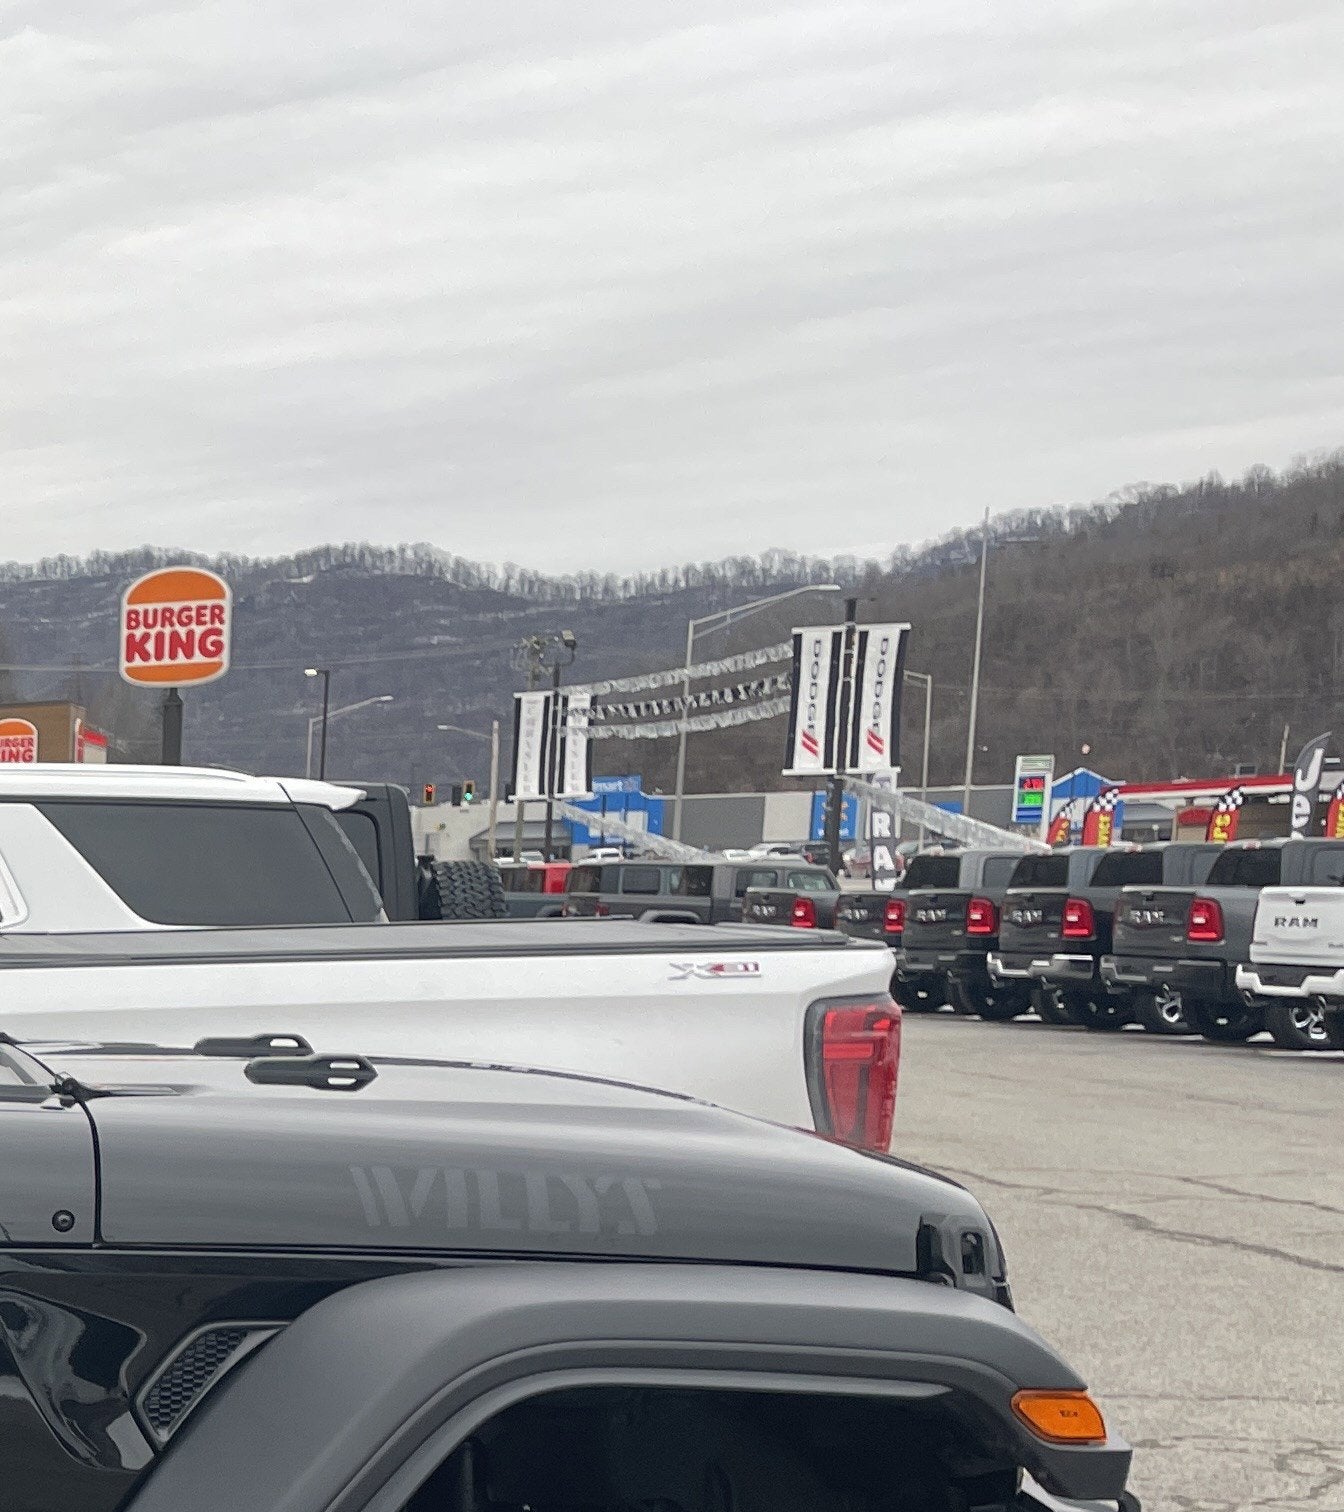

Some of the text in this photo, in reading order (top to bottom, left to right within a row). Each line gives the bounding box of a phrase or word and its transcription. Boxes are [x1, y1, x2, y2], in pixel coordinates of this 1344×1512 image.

[126, 604, 225, 630] BURGER
[125, 627, 224, 663] KING
[1274, 916, 1318, 928] RAM
[348, 1166, 662, 1236] WILLYS
